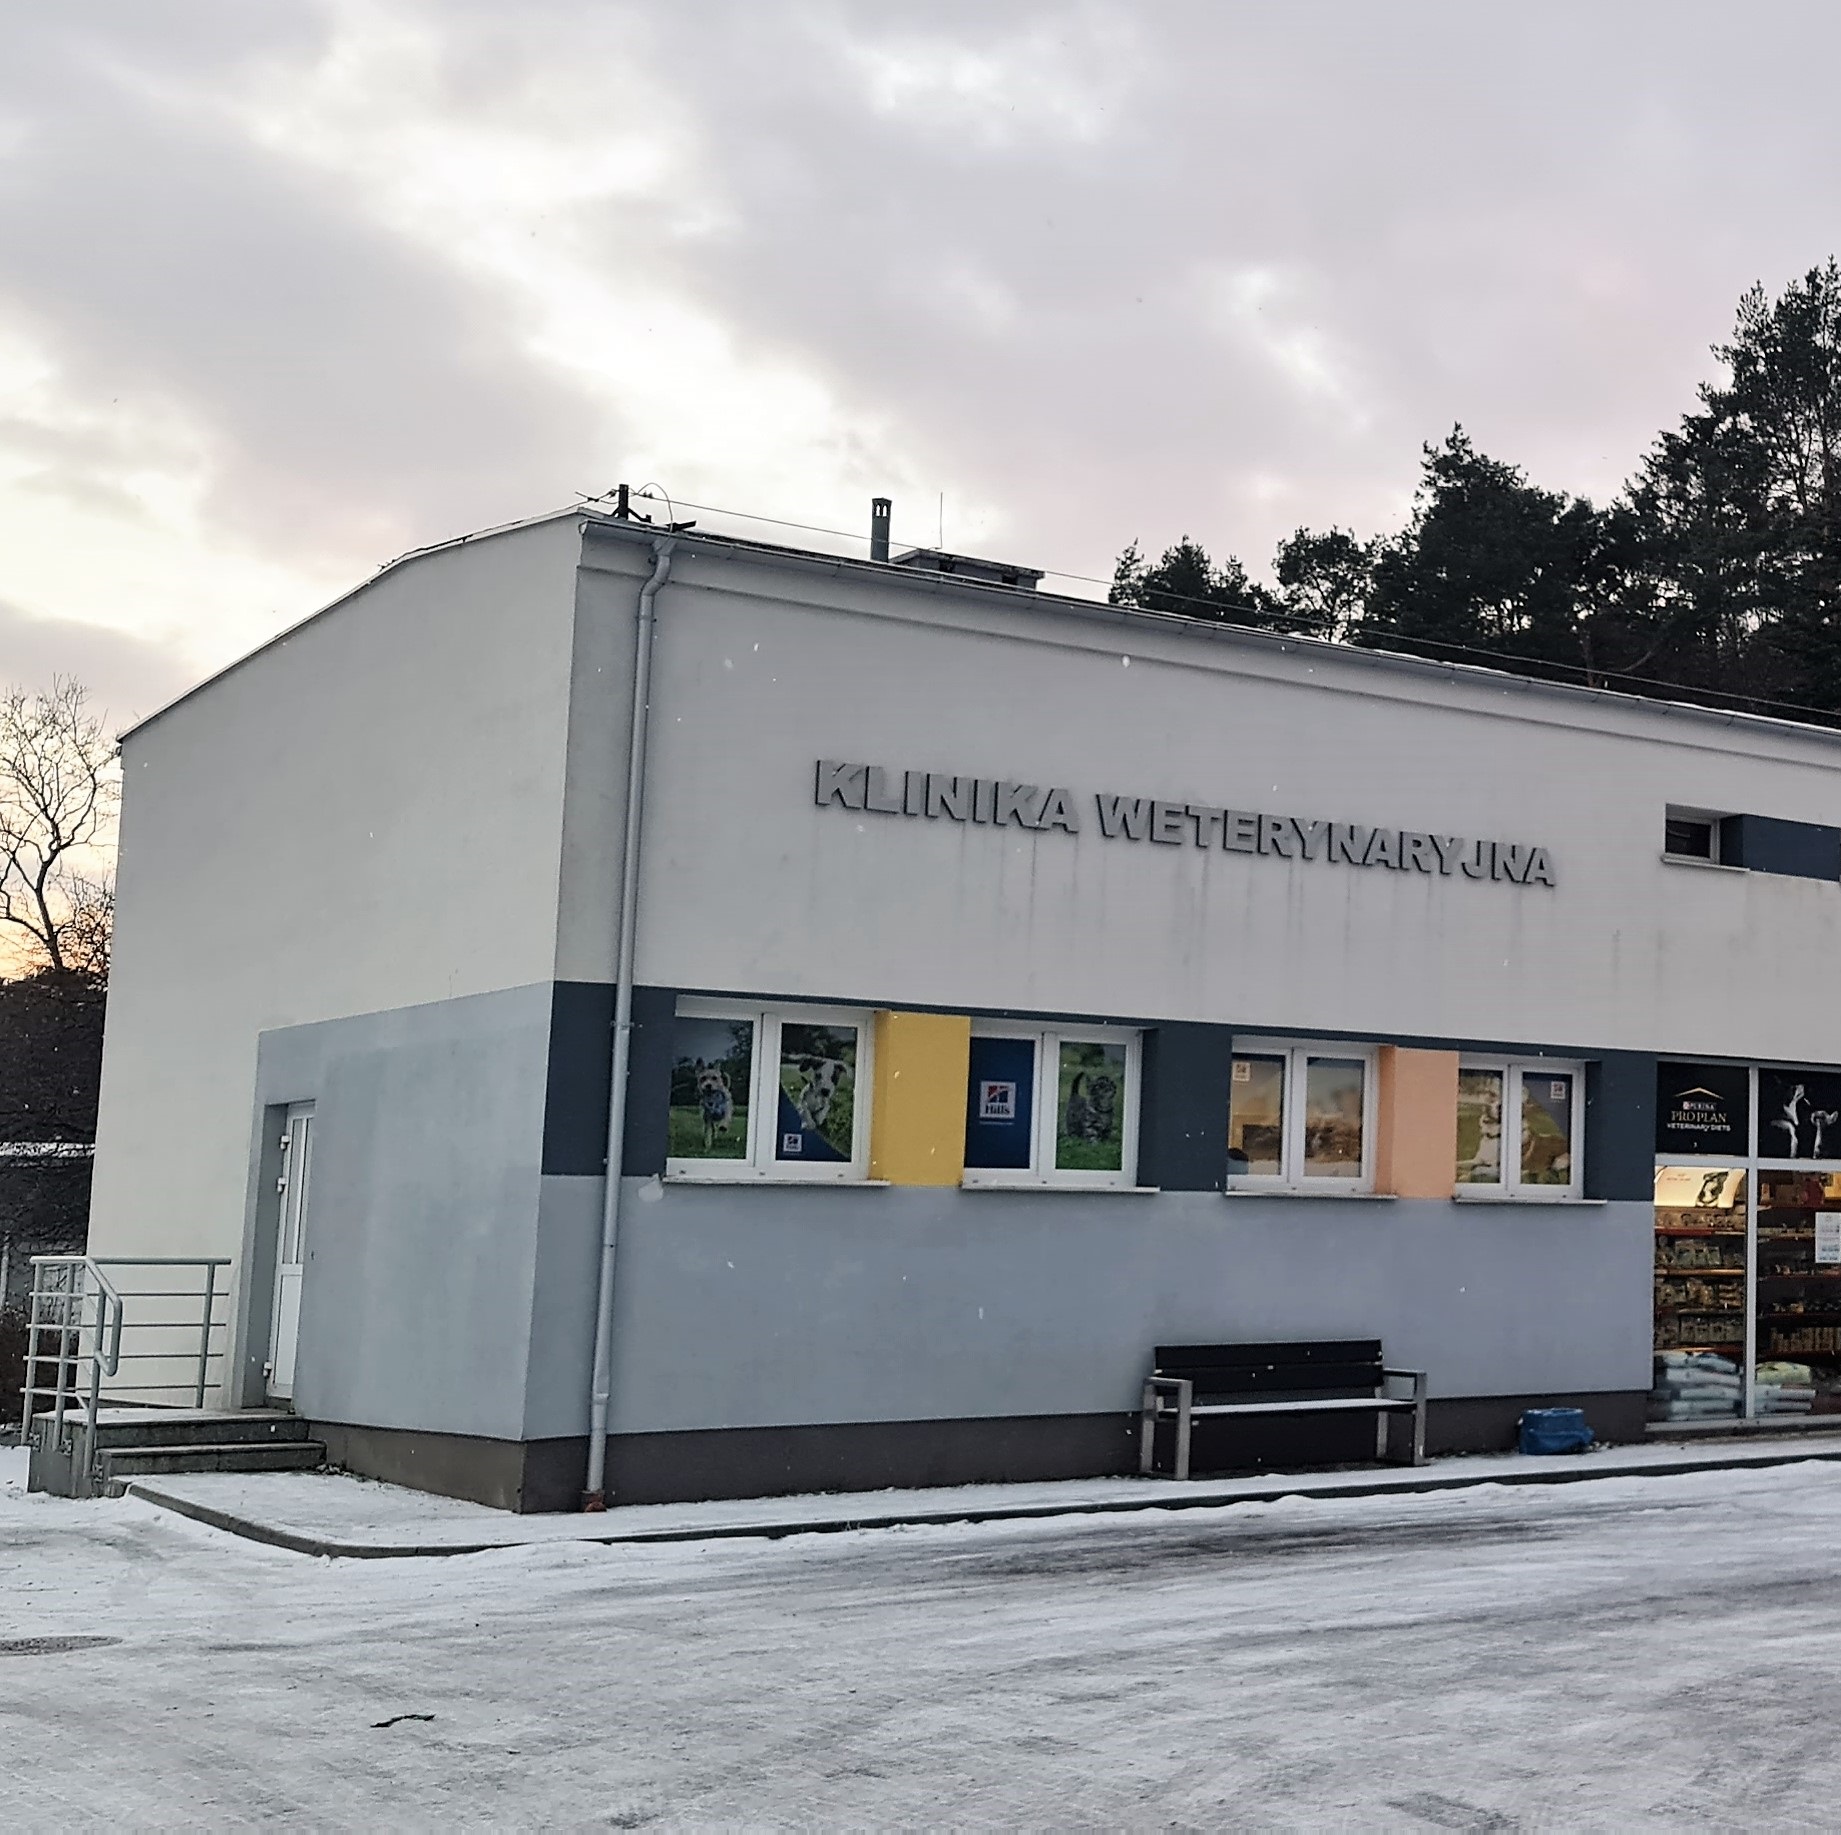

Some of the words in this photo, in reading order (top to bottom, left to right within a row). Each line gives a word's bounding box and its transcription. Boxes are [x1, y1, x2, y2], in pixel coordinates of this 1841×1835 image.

[815, 760, 1079, 833] KLINIKA
[1095, 793, 1556, 887] WETERYNARYJNA
[1671, 1110, 1696, 1122] PRO
[1697, 1112, 1728, 1123] PLAN
